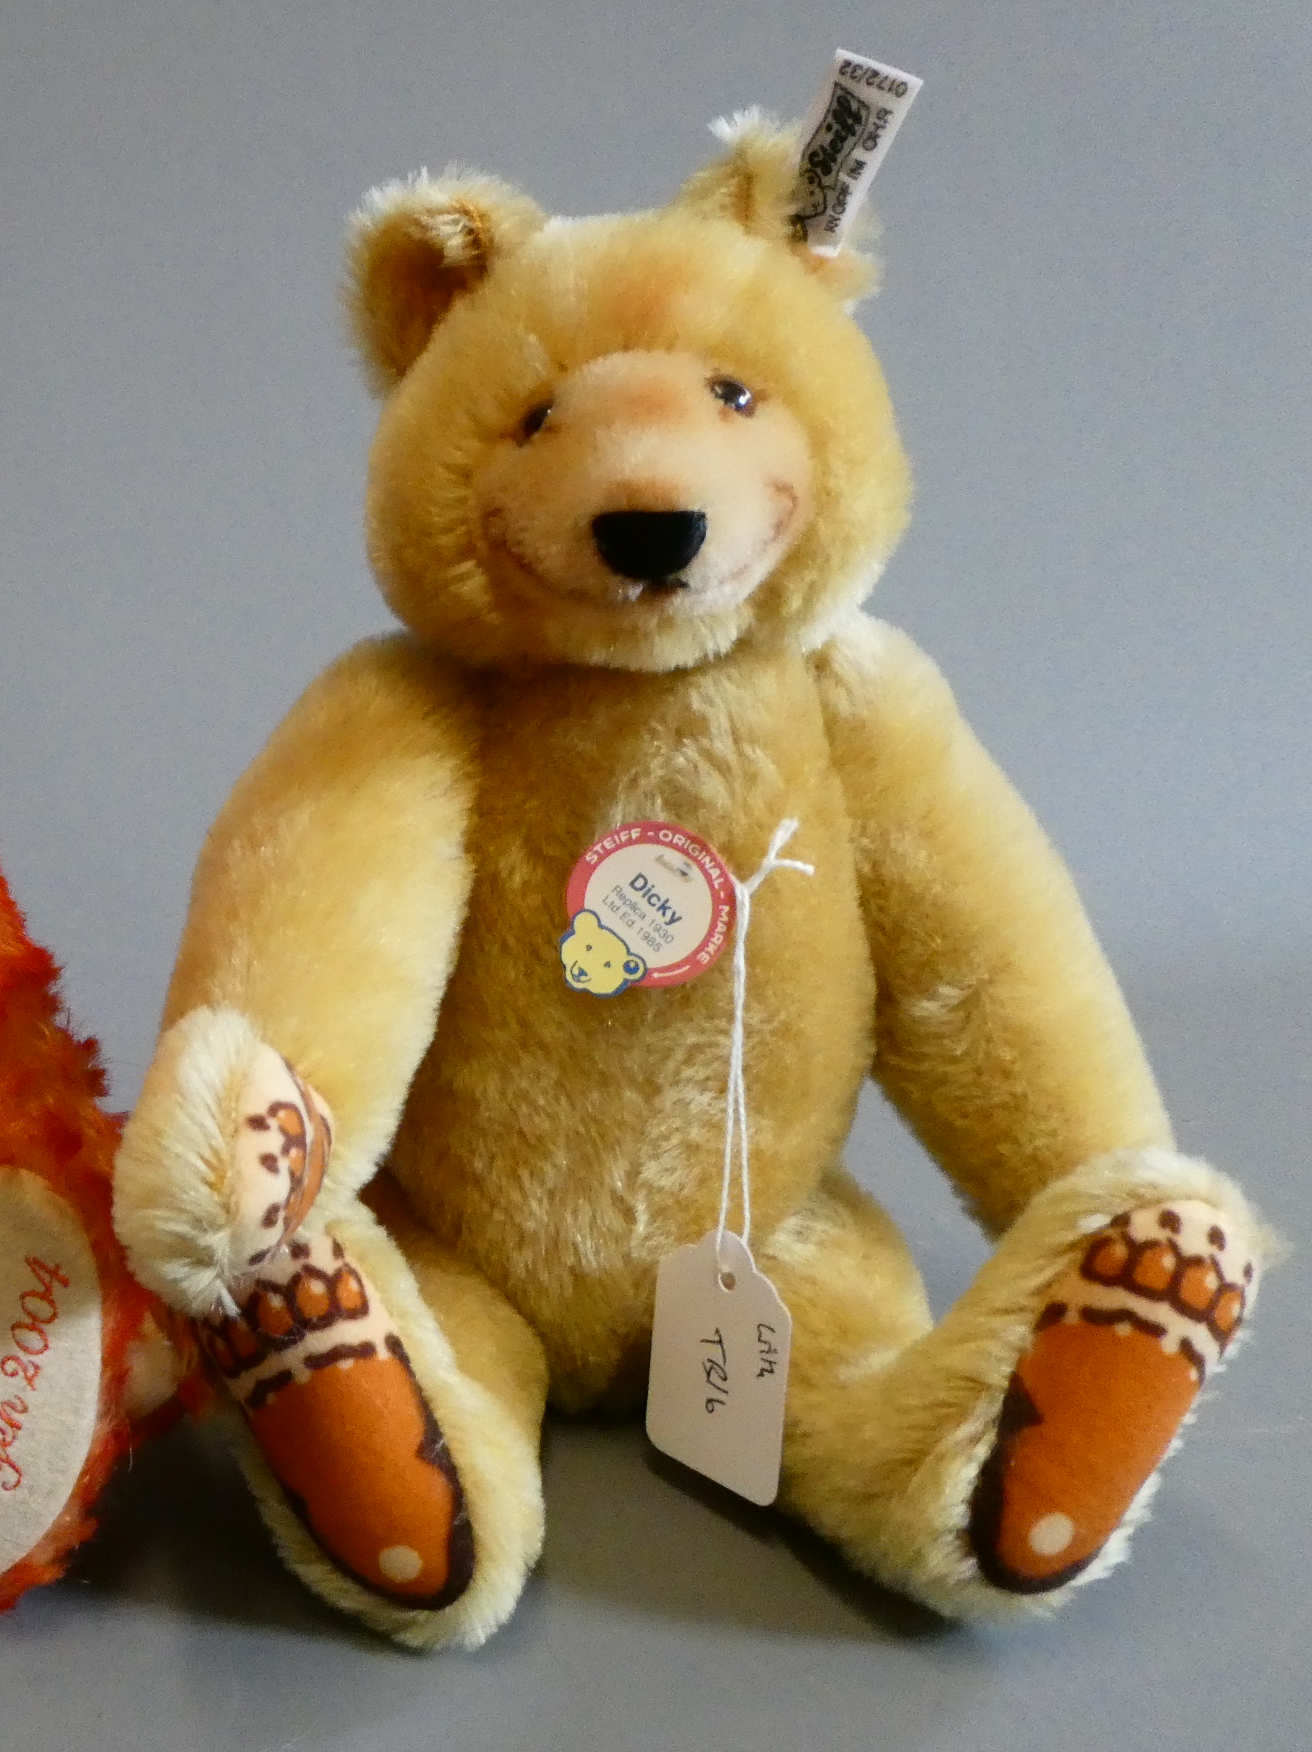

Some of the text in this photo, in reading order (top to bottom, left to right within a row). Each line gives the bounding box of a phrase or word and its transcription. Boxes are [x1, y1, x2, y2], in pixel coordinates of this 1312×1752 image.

[839, 59, 909, 99] 0172/32
[585, 827, 642, 865] STEIFF
[658, 829, 725, 890] ORIGINAL
[696, 905, 730, 965] MARKE
[611, 885, 675, 945] Replica 1930
[629, 871, 683, 926] Dicky
[636, 927, 663, 953] 1985
[0, 1255, 71, 1391] 2004
